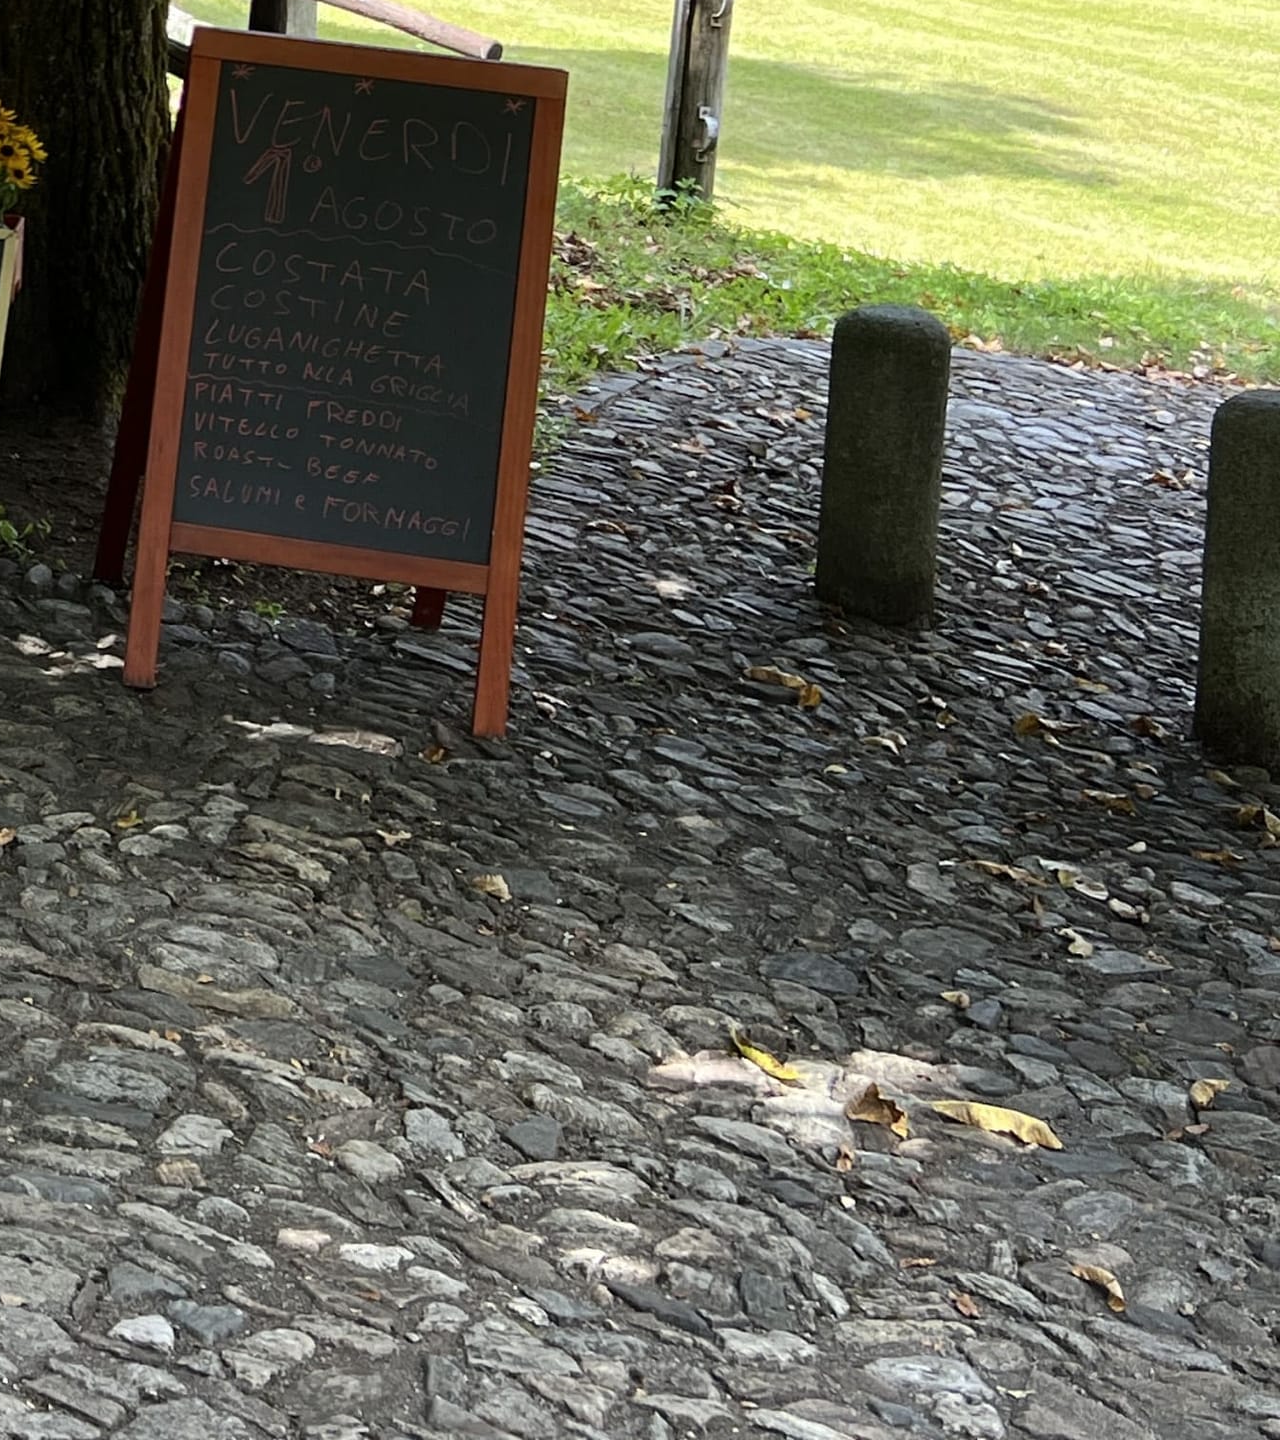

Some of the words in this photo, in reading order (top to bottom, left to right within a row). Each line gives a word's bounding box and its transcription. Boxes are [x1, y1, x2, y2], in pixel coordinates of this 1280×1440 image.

[230, 89, 513, 186] VENERDI
[309, 185, 497, 244] AGOSTO
[215, 242, 430, 305] COSTATA
[210, 284, 410, 338] COSTINE
[204, 319, 444, 376] LUGANIGHETTA
[195, 382, 283, 410] PIATTI
[307, 400, 403, 433] FREDDI
[204, 353, 288, 375] TUTTO
[304, 362, 353, 387] ALLA
[370, 375, 471, 416] GRIGLIA
[194, 412, 299, 439] VITELLO
[320, 434, 438, 470] TONNATO
[190, 475, 280, 505] SALUMI
[323, 496, 471, 543] FORMAGGI
